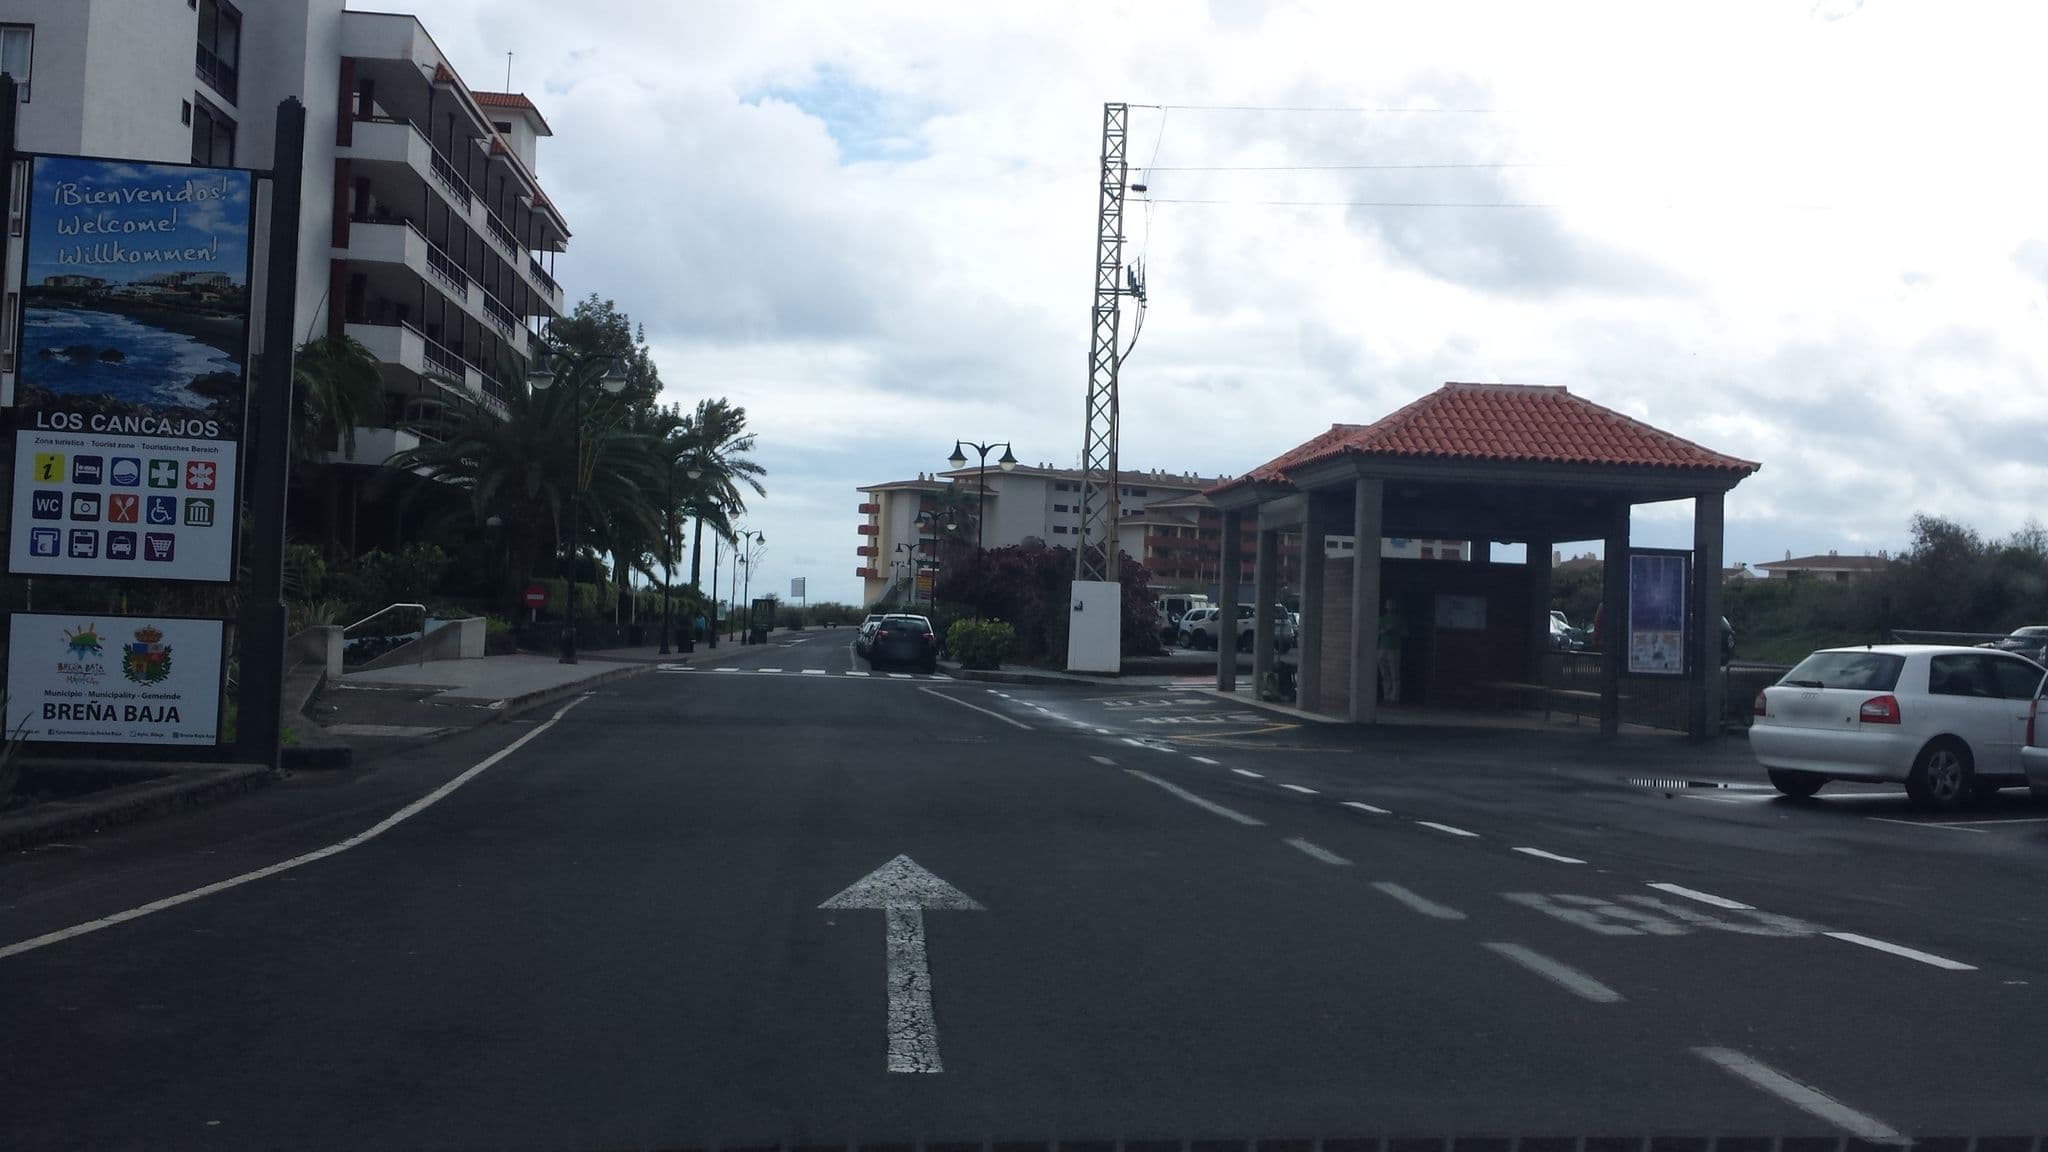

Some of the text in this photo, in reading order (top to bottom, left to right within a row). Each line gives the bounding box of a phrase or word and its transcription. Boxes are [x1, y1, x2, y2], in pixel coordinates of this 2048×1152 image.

[54, 176, 227, 206] ¡Bienvenidos!
[57, 207, 177, 235] Welcome!
[59, 236, 217, 264] Willkommen!
[36, 411, 219, 437] LOS CANCAJOS
[34, 437, 53, 445] Zona
[91, 440, 116, 448] Tourist
[191, 445, 219, 454] Bereich
[36, 498, 59, 512] WC
[44, 689, 181, 700] Municipio Municipality Gemeinde
[42, 701, 180, 723] BREÑA BAJA
